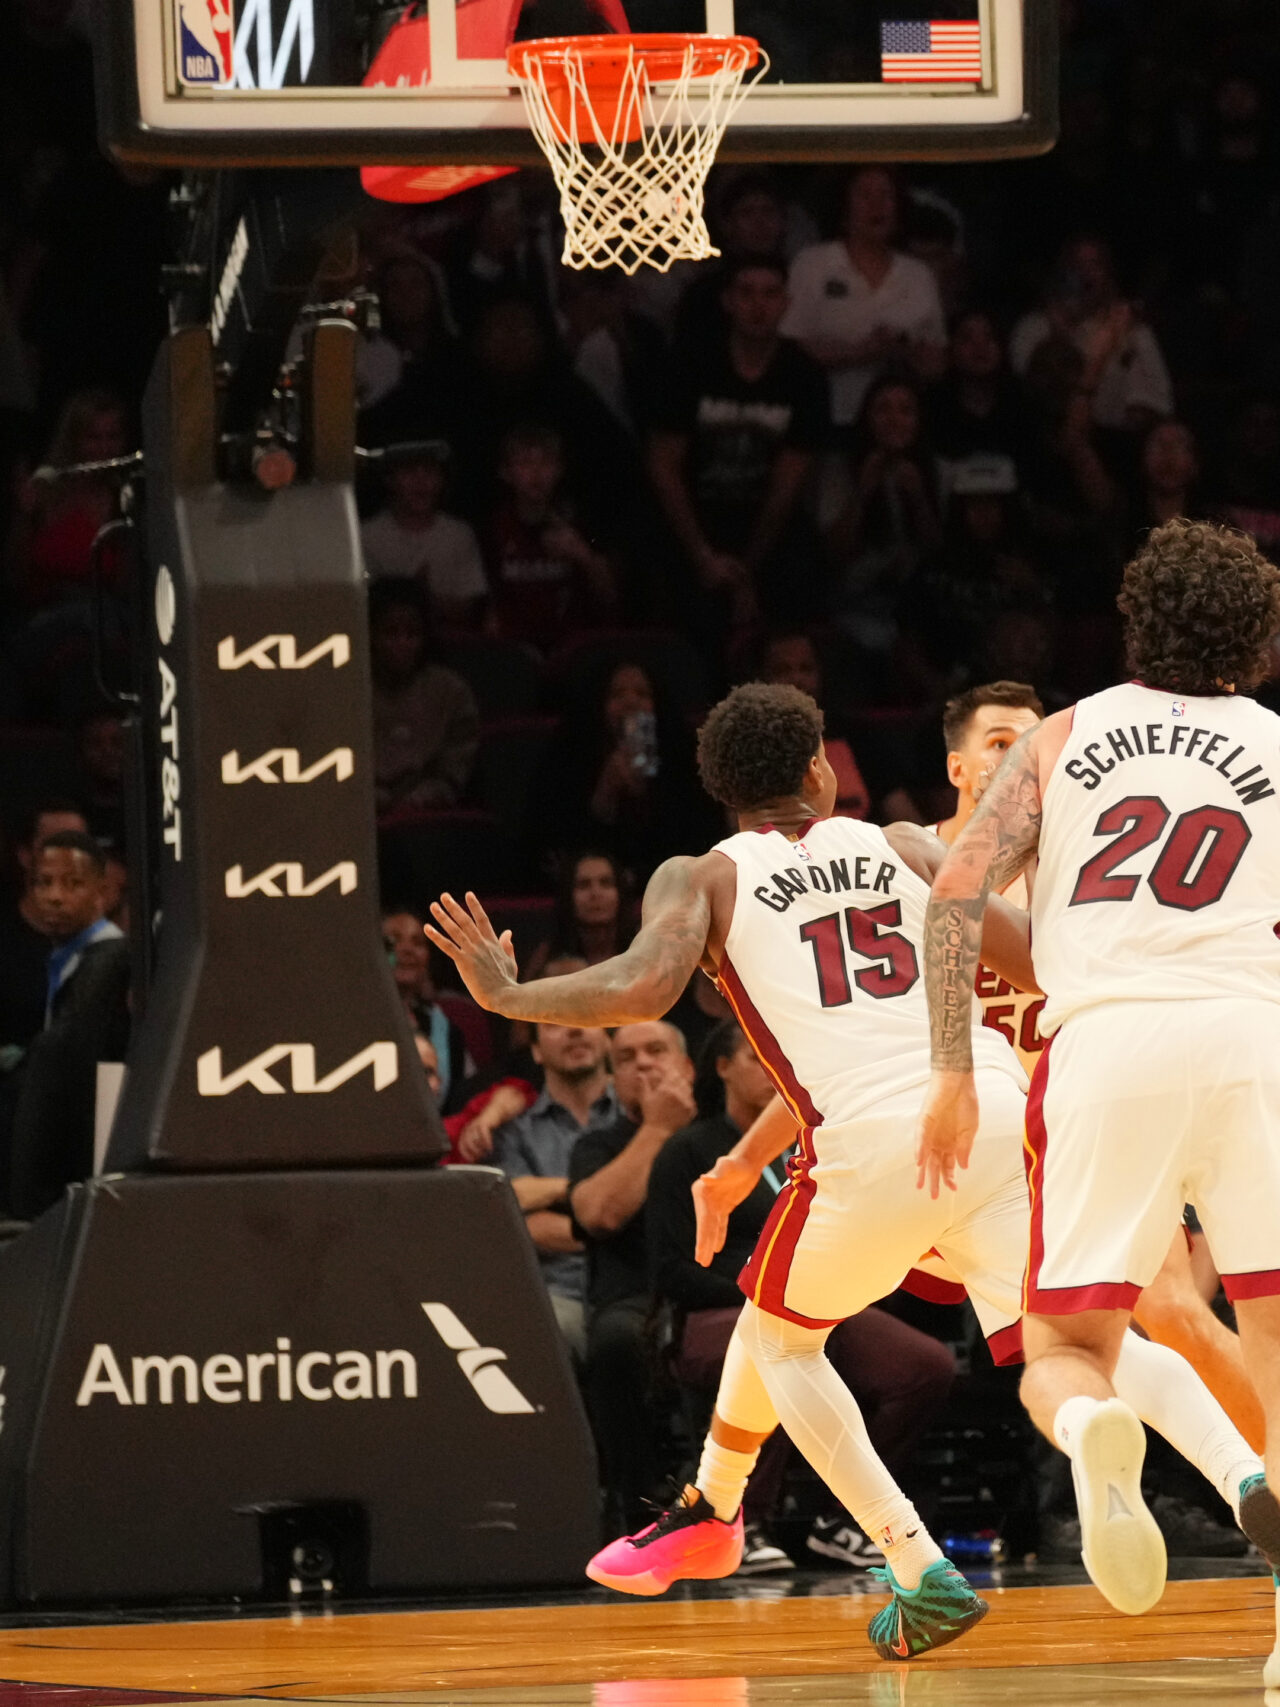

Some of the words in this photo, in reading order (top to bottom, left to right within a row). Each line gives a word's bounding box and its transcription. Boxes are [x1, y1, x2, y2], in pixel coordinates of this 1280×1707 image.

[186, 56, 214, 78] NBA
[217, 633, 350, 670] KIA
[158, 656, 182, 862] AT&T
[221, 747, 354, 784] KIA
[1065, 723, 1275, 806] SCHIEFFELIN
[225, 861, 358, 898] KIA
[1068, 795, 1253, 912] 20
[753, 856, 897, 912] GARDNER
[799, 898, 920, 1008] 15
[197, 1041, 398, 1096] KIA
[76, 1337, 418, 1406] American
